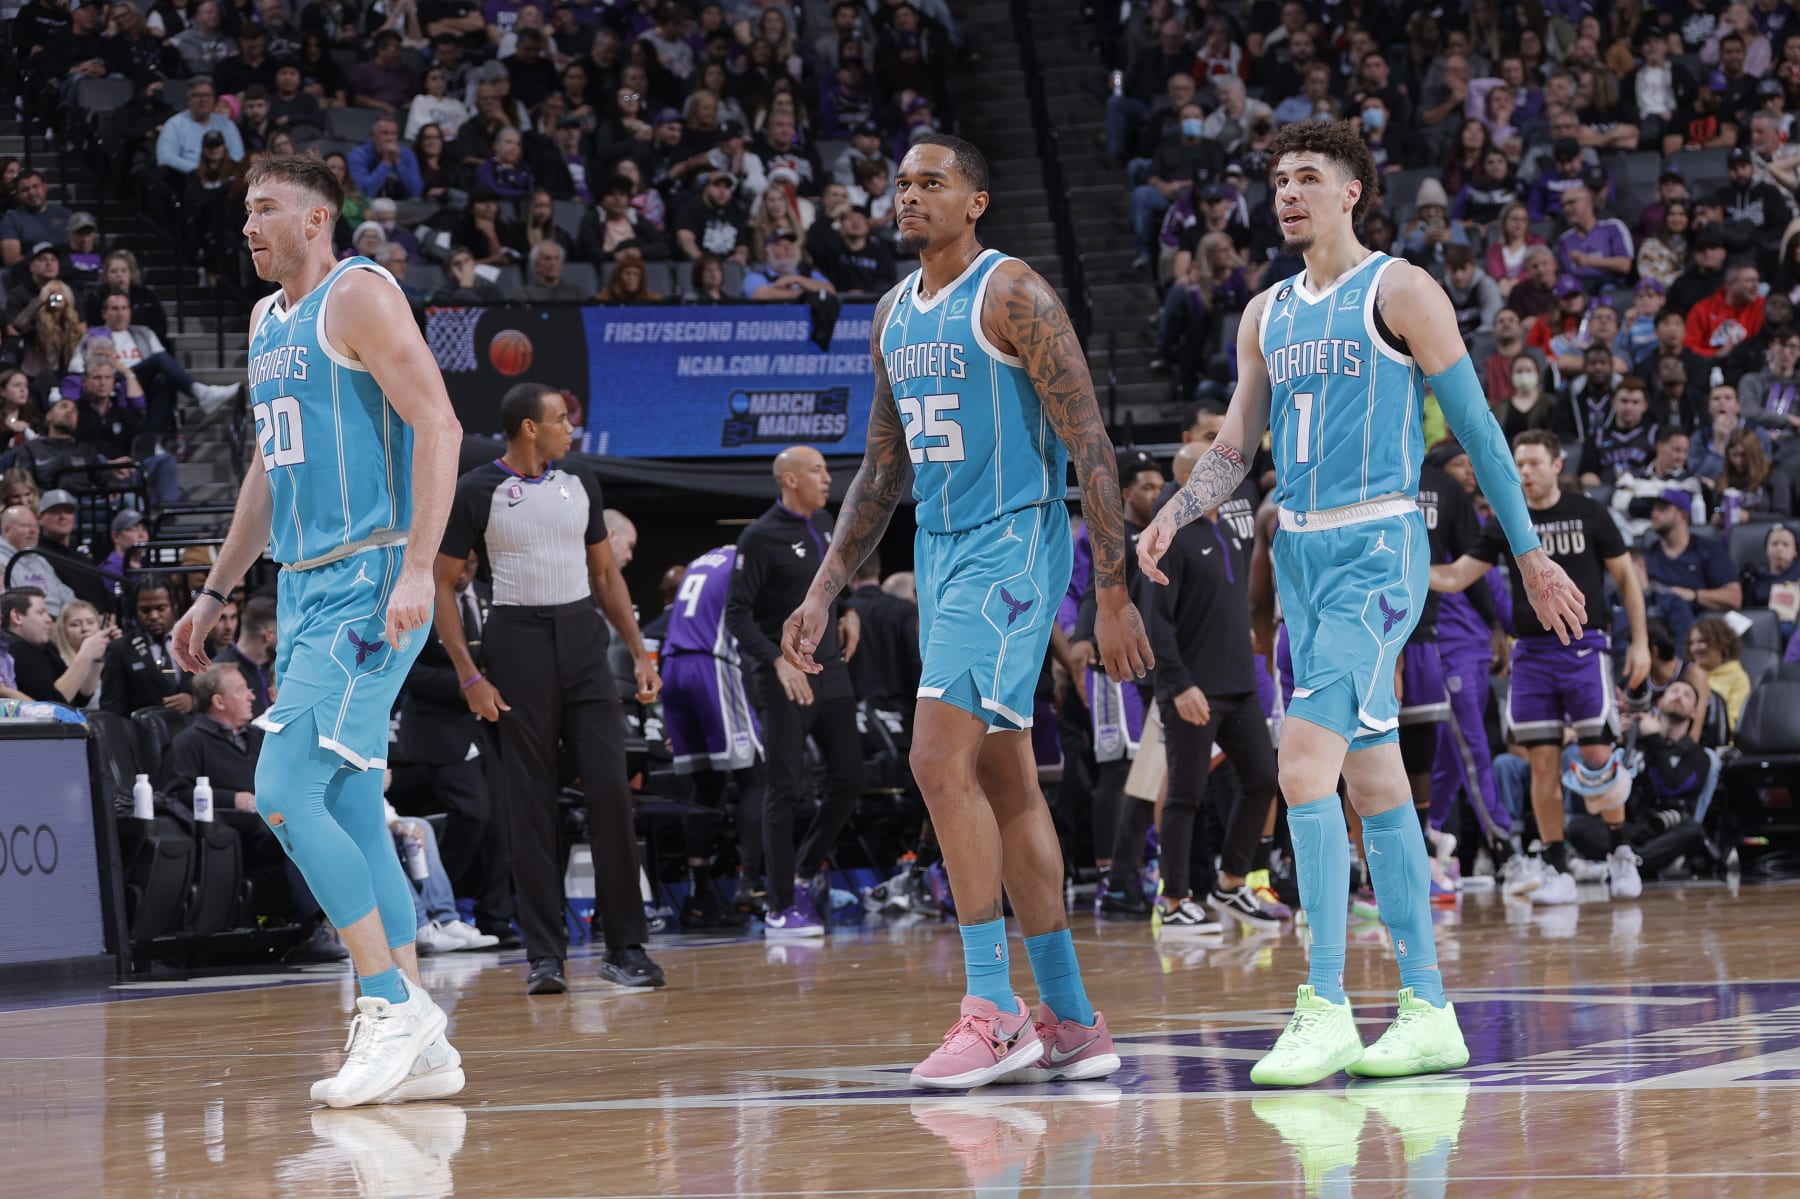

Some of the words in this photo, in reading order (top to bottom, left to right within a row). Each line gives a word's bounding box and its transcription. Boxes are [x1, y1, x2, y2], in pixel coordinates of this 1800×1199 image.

[603, 322, 732, 343] FIRST/SECOND
[735, 320, 810, 341] ROUNDS
[885, 341, 969, 389] HORNETS
[1265, 338, 1366, 391] HORNETS
[748, 392, 817, 414] MARCH
[757, 413, 848, 436] MADNESS
[253, 395, 306, 472] 20
[898, 393, 967, 464] 25
[1293, 392, 1314, 464] 1
[678, 573, 707, 617] 9
